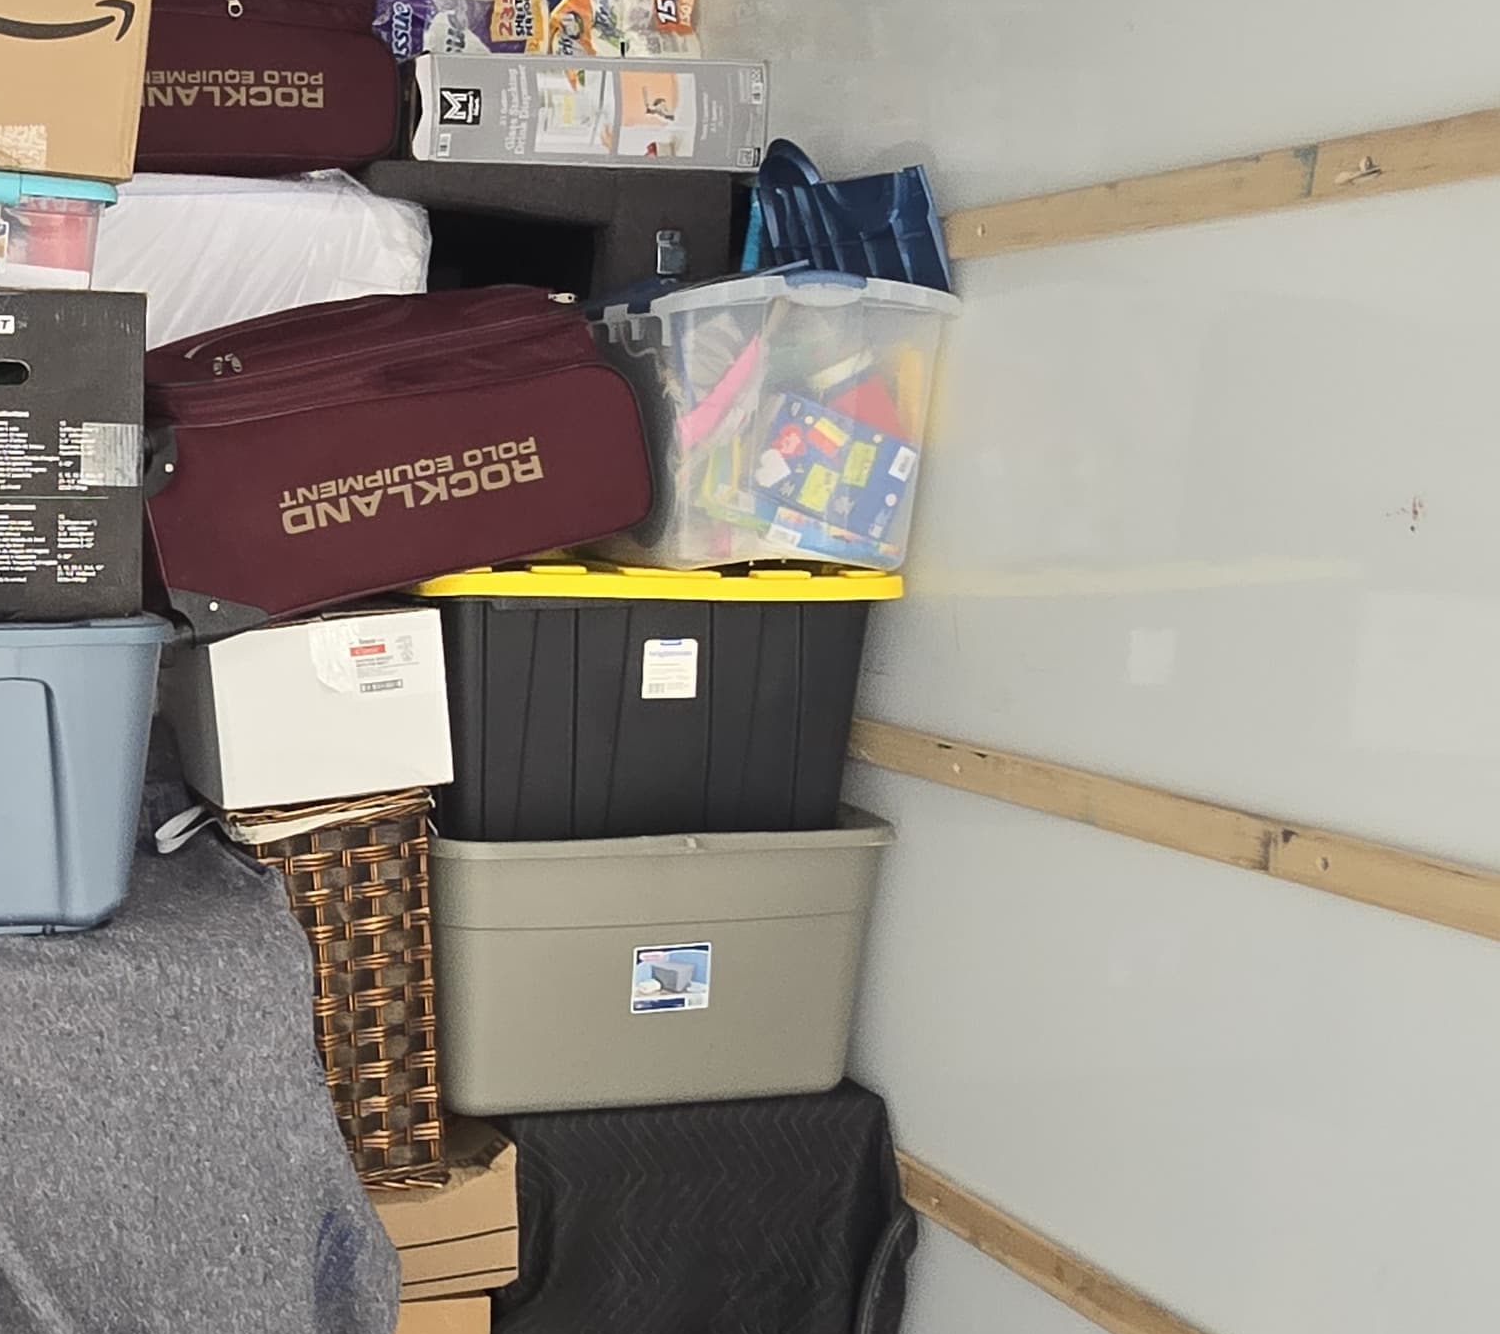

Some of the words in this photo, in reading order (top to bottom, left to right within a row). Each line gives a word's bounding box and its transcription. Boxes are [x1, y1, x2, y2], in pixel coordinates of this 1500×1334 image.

[144, 68, 255, 85] EQUIPME
[262, 70, 324, 86] POLO
[141, 84, 325, 109] ROCKLAN
[462, 436, 538, 468] POLO
[278, 454, 455, 509] EQUIPMENT
[281, 454, 545, 536] ROCKLAND
